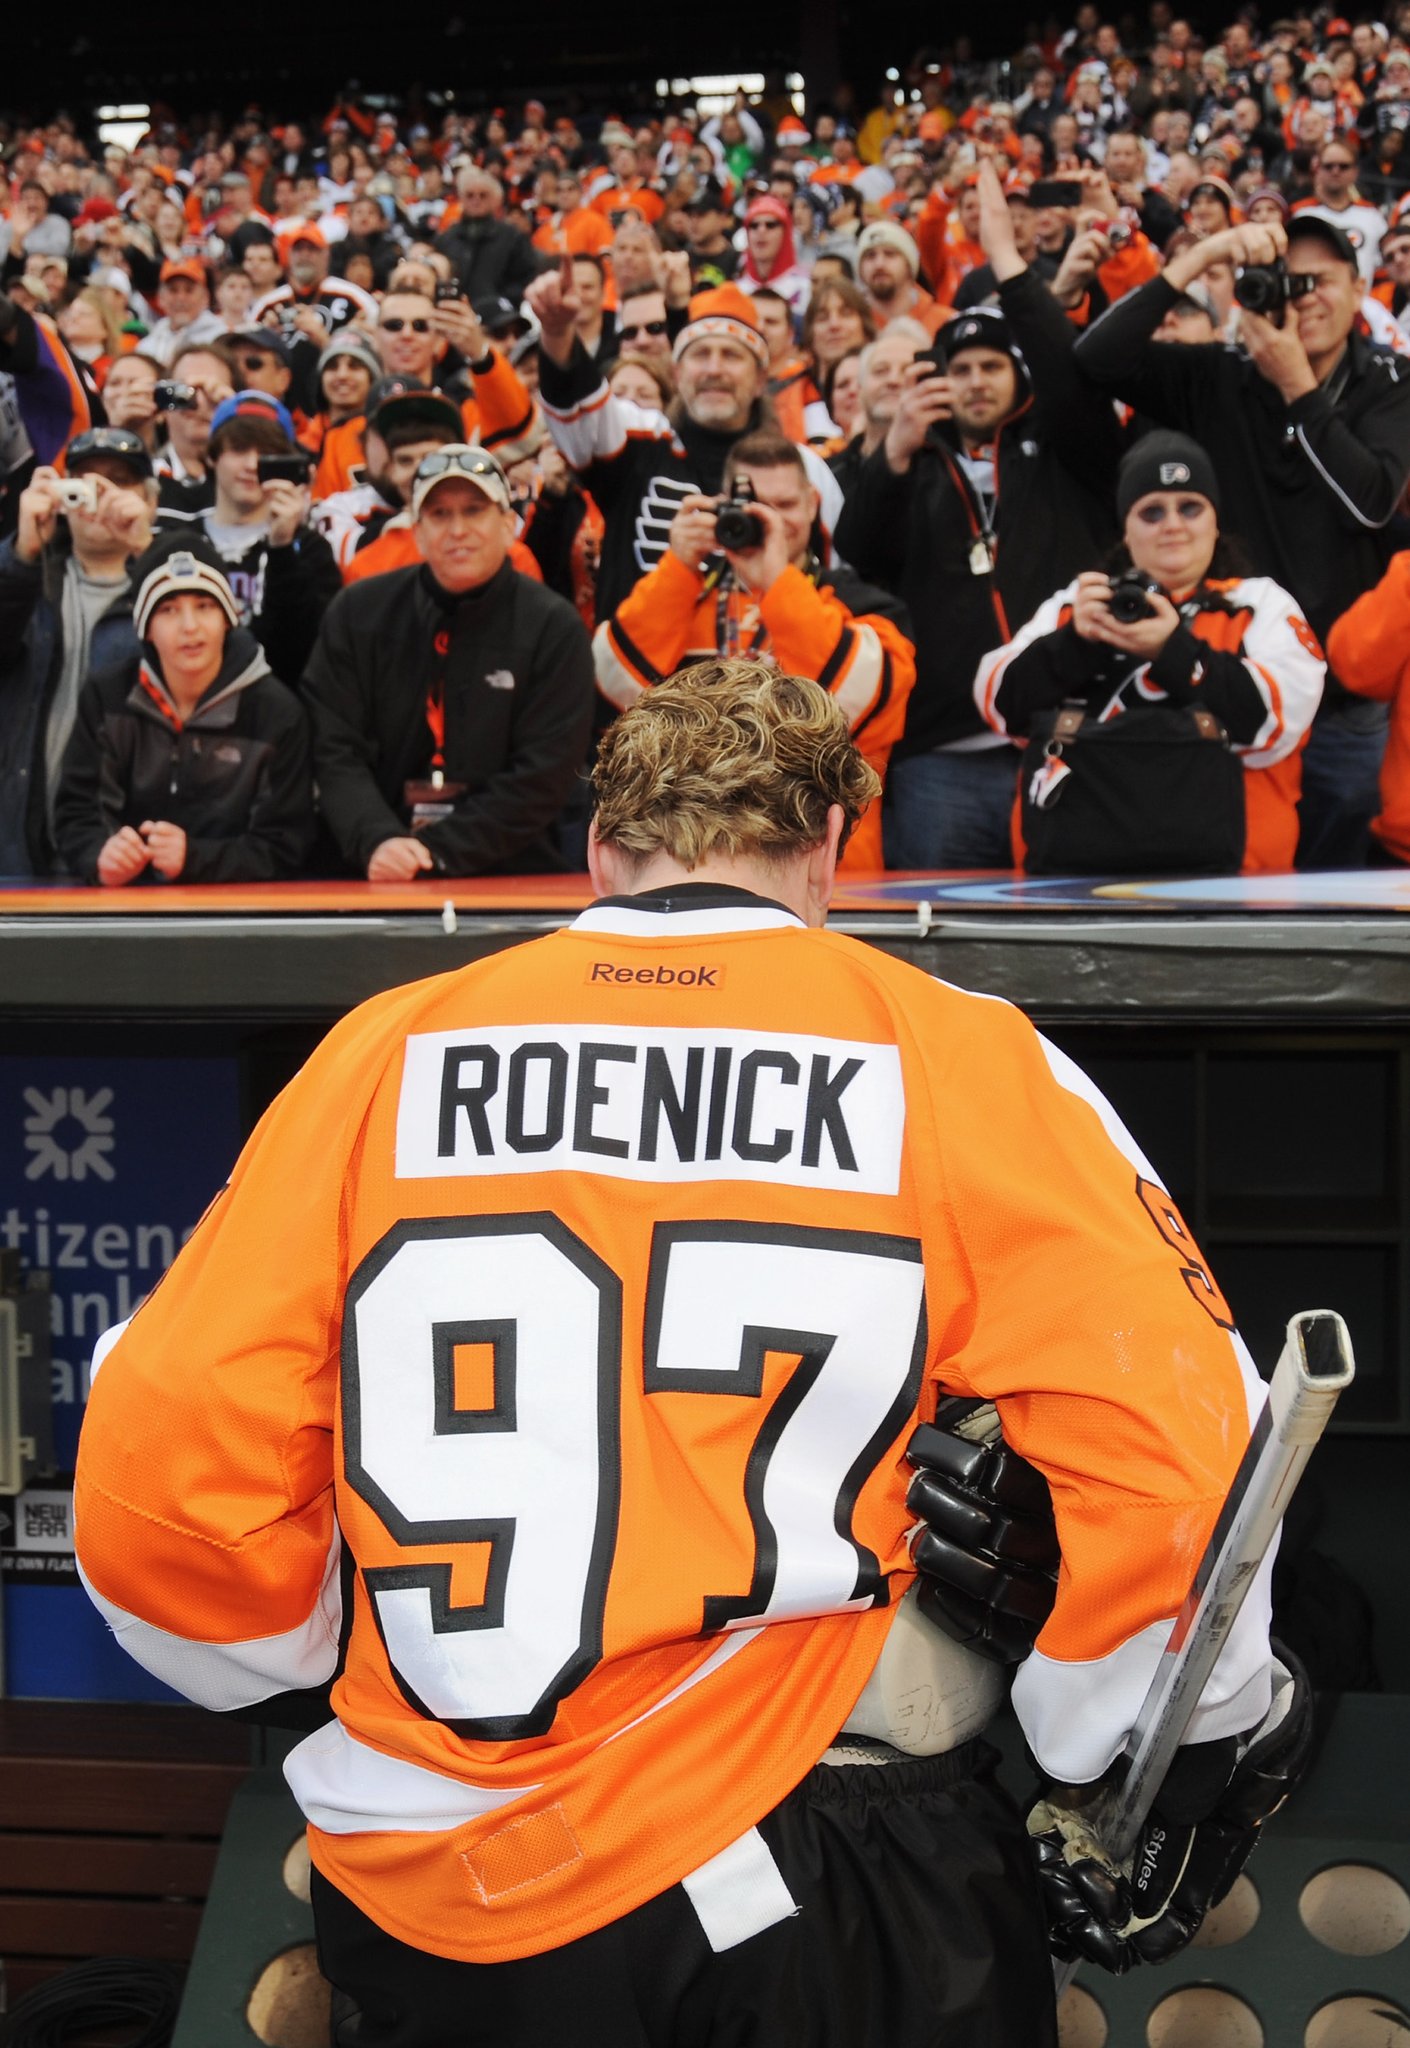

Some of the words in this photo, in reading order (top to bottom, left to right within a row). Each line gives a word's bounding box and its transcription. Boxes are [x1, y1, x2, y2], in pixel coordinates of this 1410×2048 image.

[591, 963, 718, 986] Reebok
[437, 1042, 867, 1172] ROENICK
[0, 1208, 196, 1270] tizen
[340, 1210, 929, 1742] 97
[24, 1504, 67, 1520] NEW
[25, 1521, 67, 1538] ERA
[15, 1557, 45, 1570] OWN
[1137, 1827, 1166, 1891] Styles
